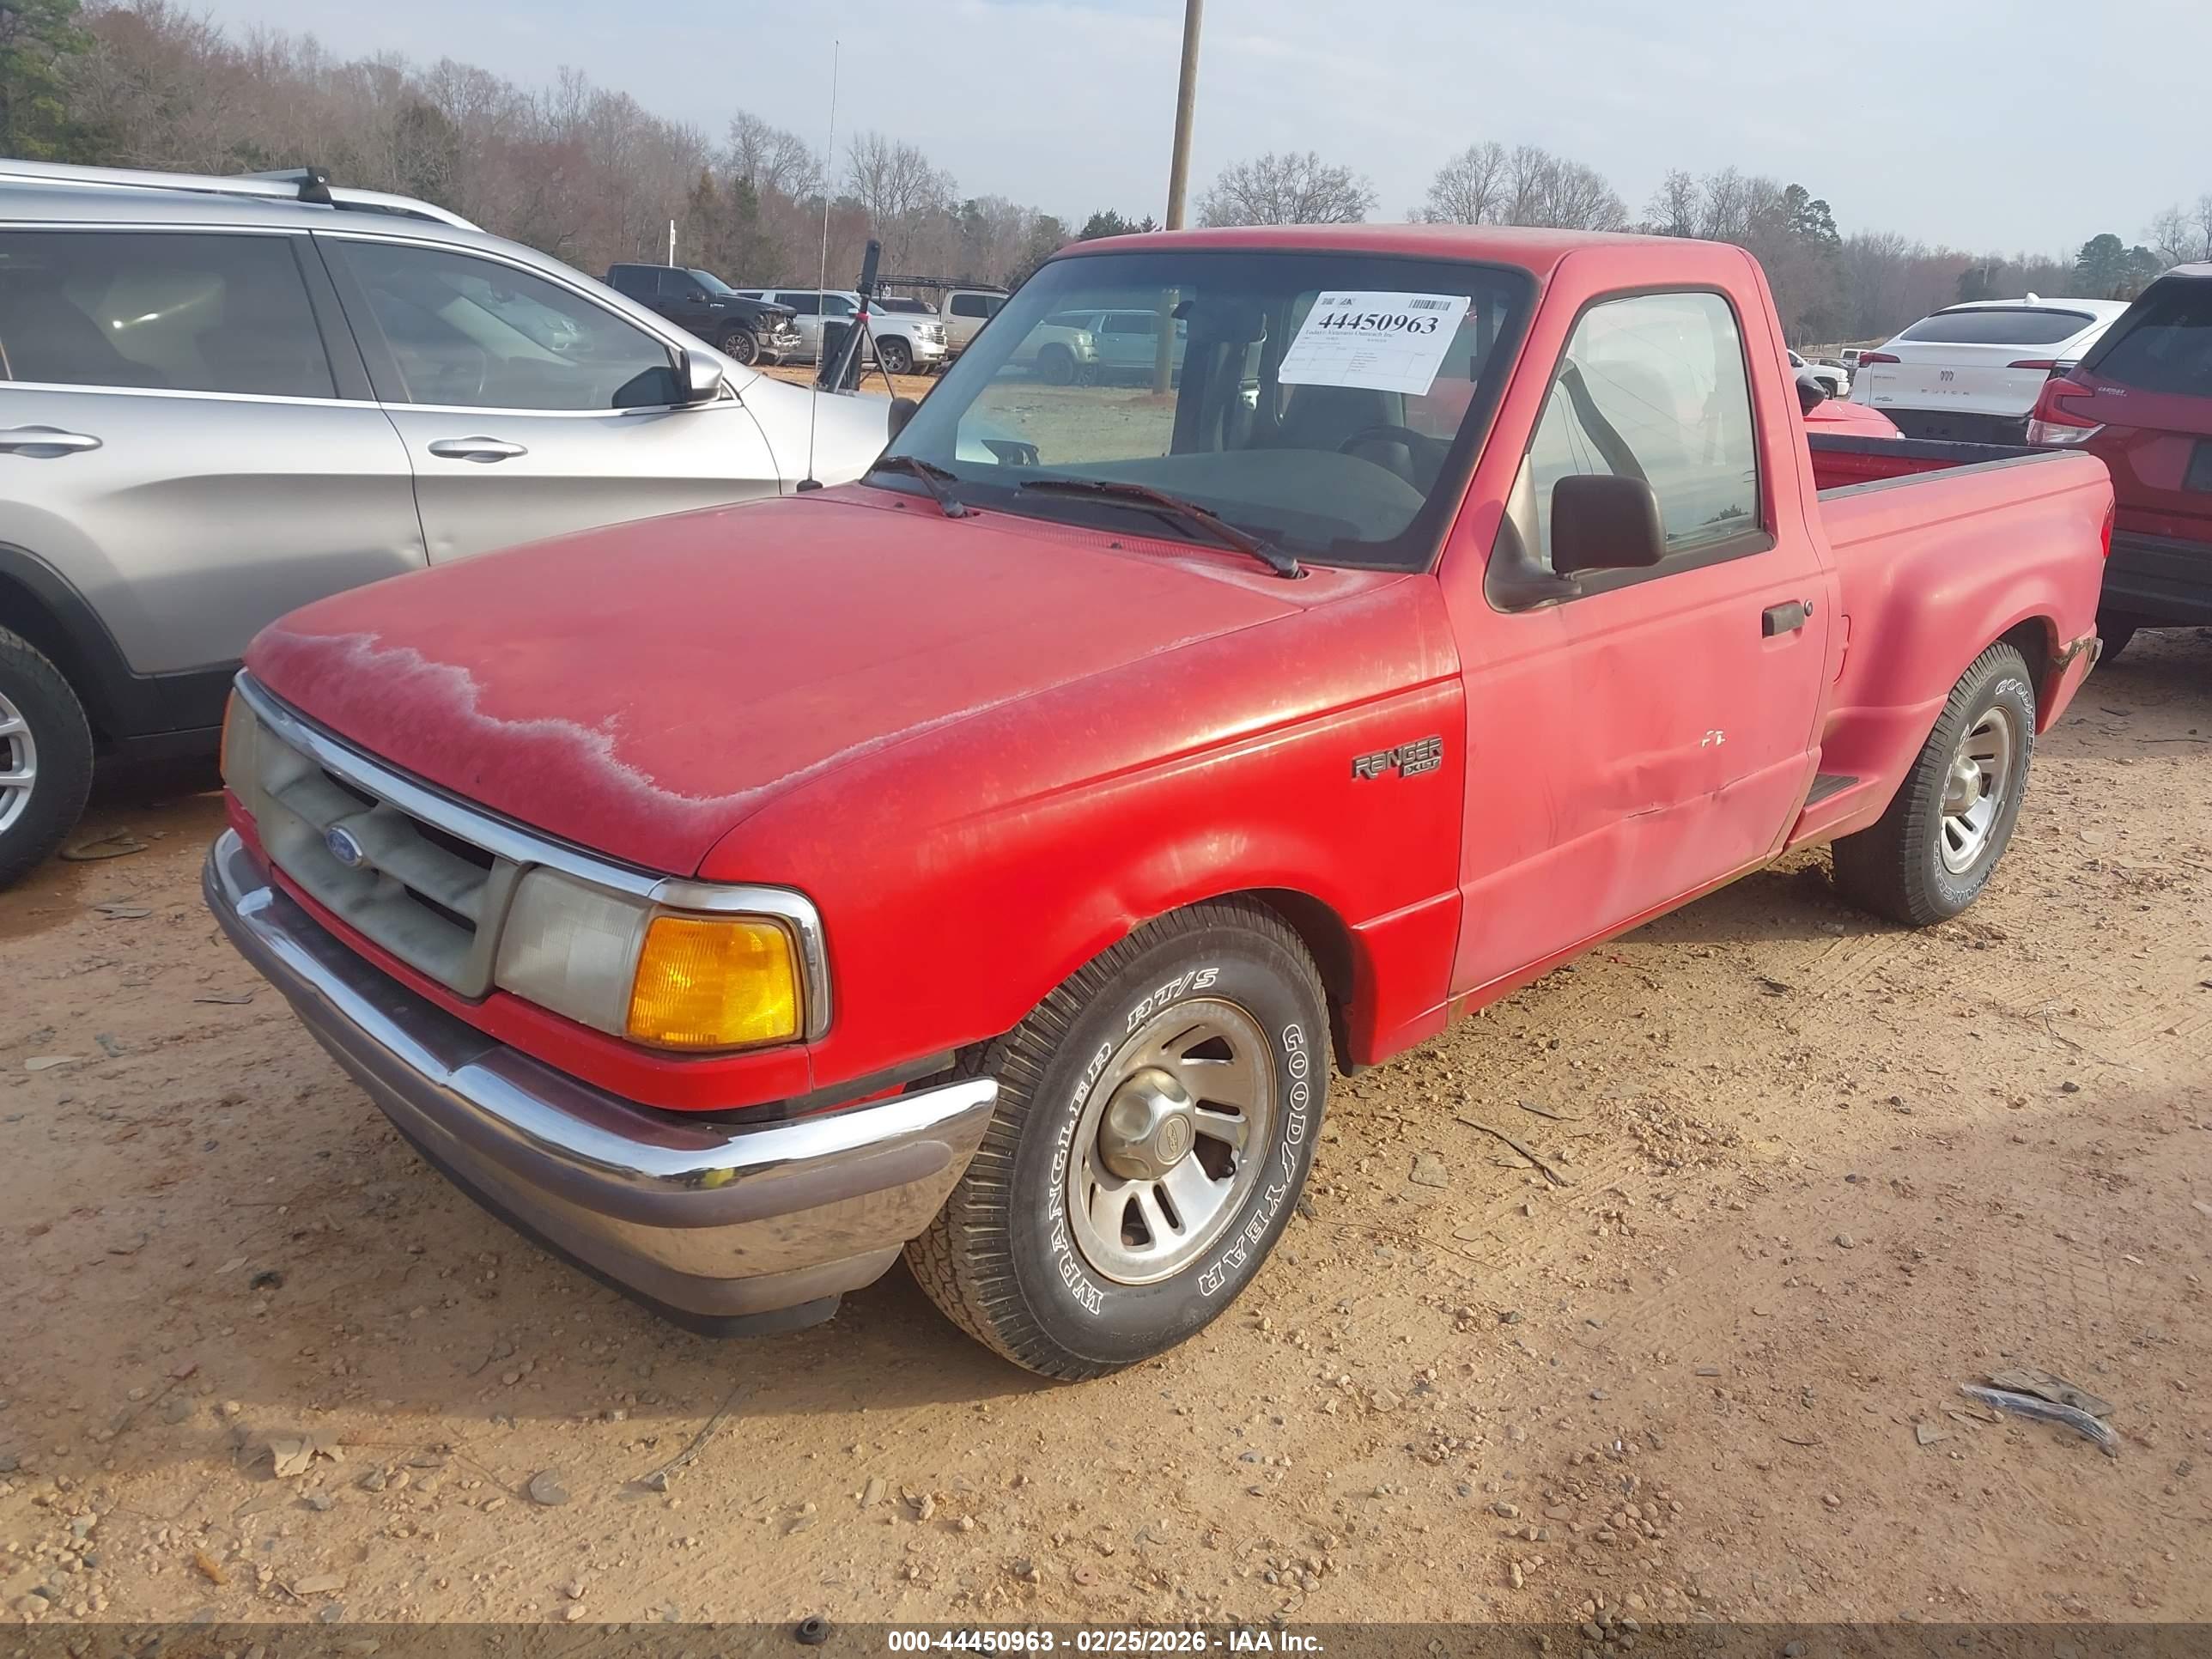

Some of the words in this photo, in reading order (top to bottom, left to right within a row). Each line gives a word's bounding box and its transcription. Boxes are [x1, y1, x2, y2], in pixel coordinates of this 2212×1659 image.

[1318, 313, 1438, 333] 44450963
[1352, 737, 1443, 779] RANGER
[1048, 1042, 1113, 1316] WRANGLER
[1126, 967, 1220, 1035] RT/S
[1199, 1024, 1310, 1298] GOODYEAR
